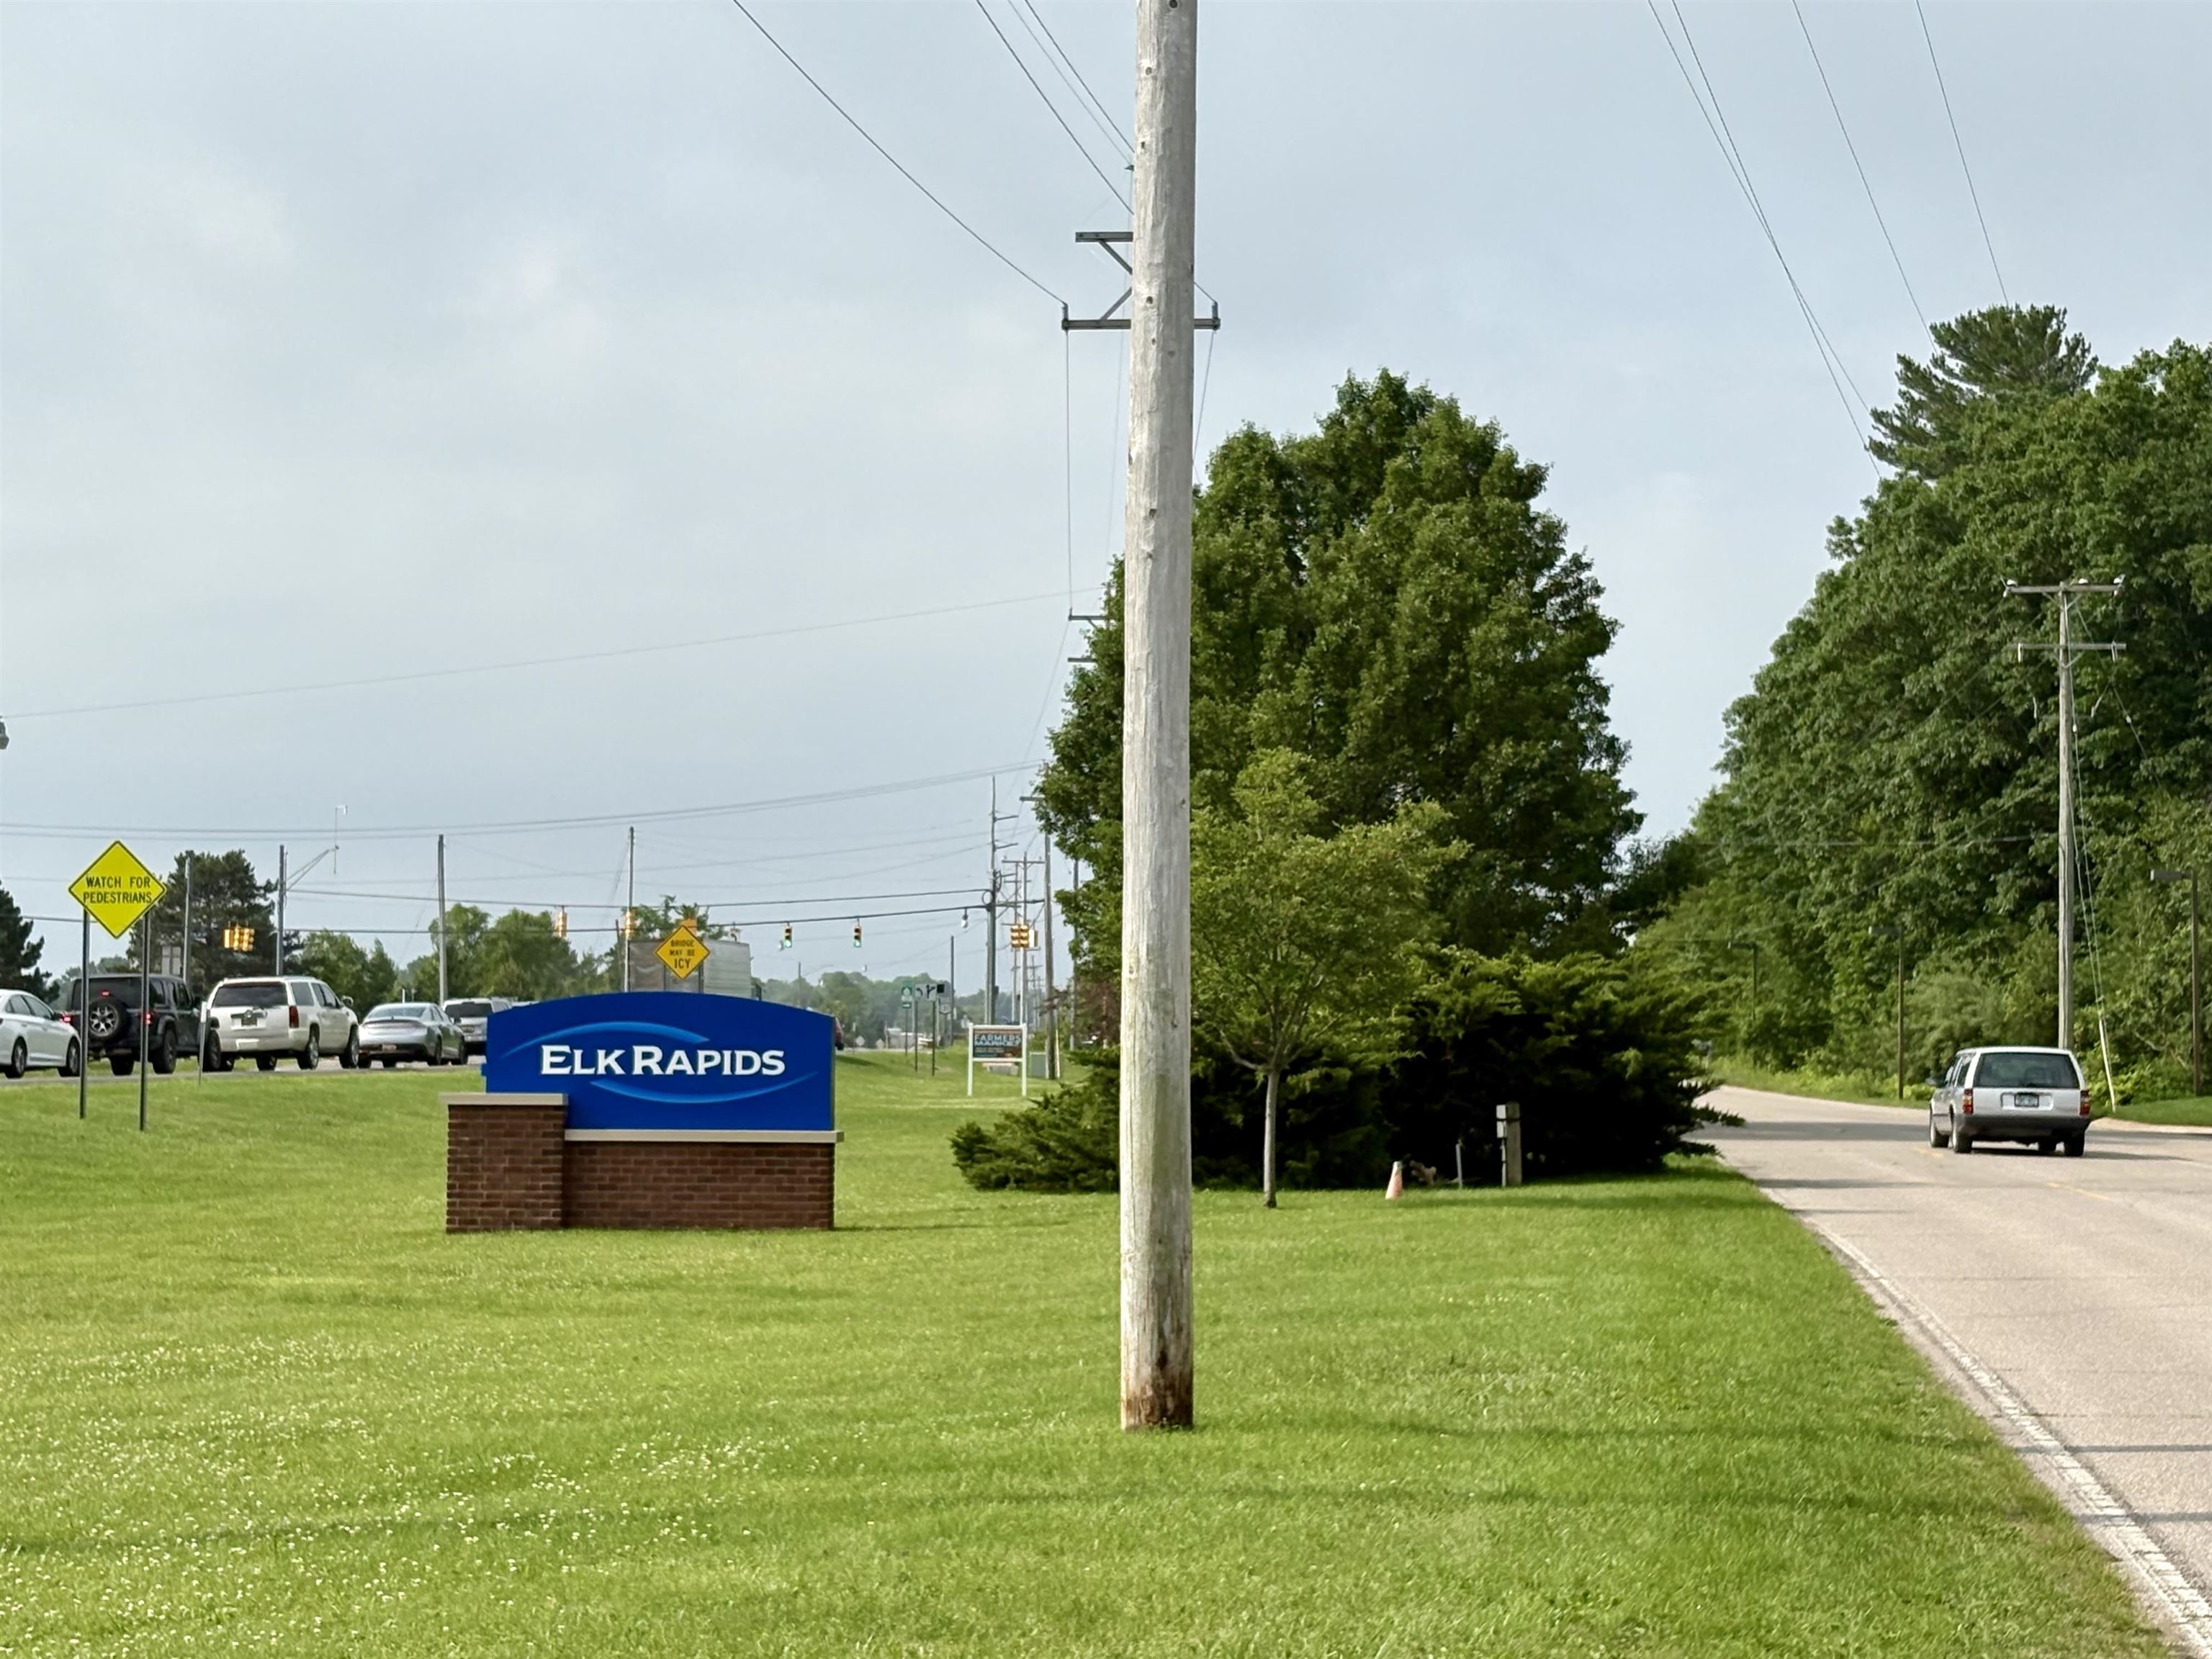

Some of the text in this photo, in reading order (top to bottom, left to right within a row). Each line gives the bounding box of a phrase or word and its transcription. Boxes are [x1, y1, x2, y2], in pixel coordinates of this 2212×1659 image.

[86, 876, 150, 888] WATCH FOR
[84, 891, 153, 904] PEDESTRIANS
[674, 958, 691, 969] ICY
[541, 1045, 786, 1076] ELK RAPIDS
